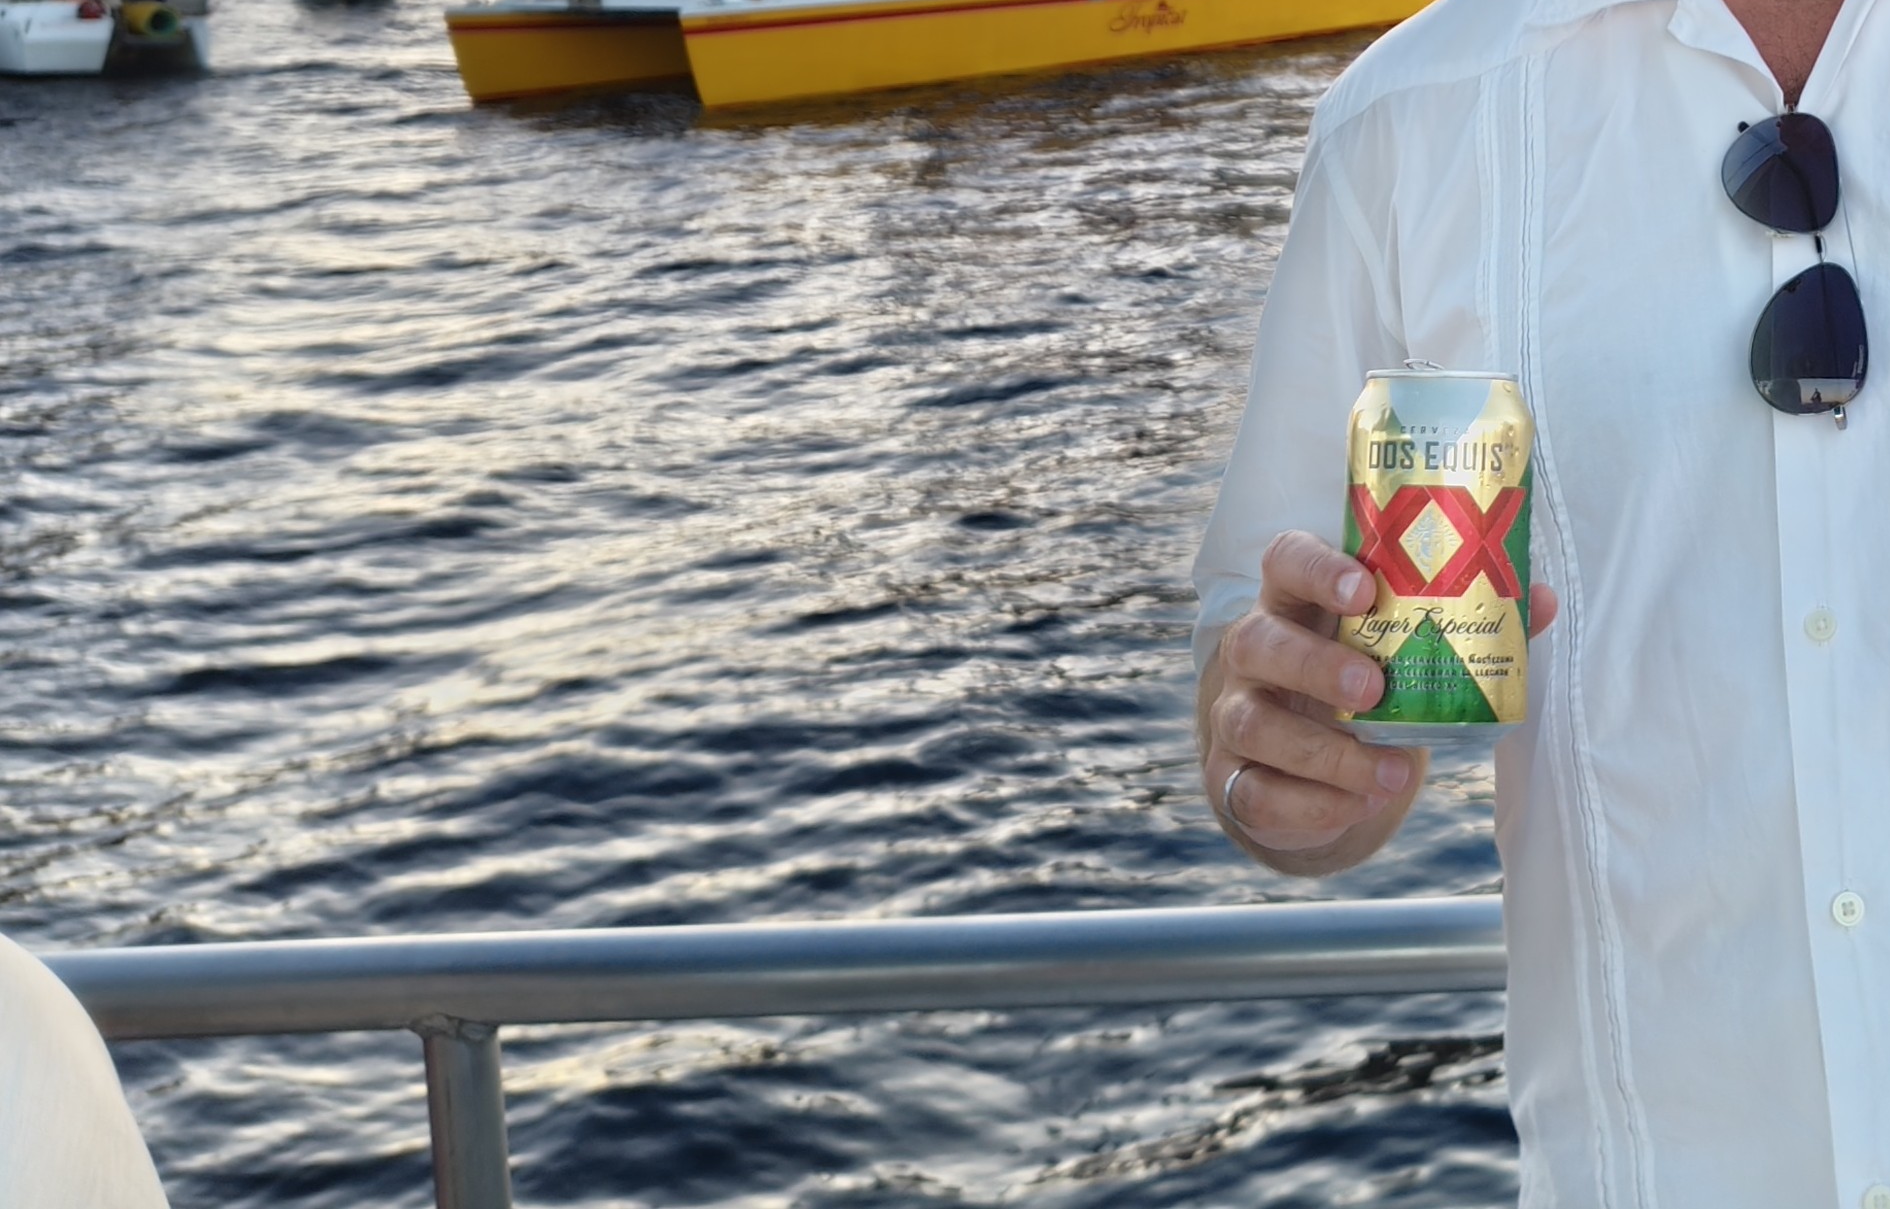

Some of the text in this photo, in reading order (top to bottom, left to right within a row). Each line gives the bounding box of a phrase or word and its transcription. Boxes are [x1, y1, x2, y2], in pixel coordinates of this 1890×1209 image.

[1369, 440, 1503, 472] DOS EQUIS
[1349, 484, 1527, 598] XX
[1352, 605, 1504, 648] Lager Especial
